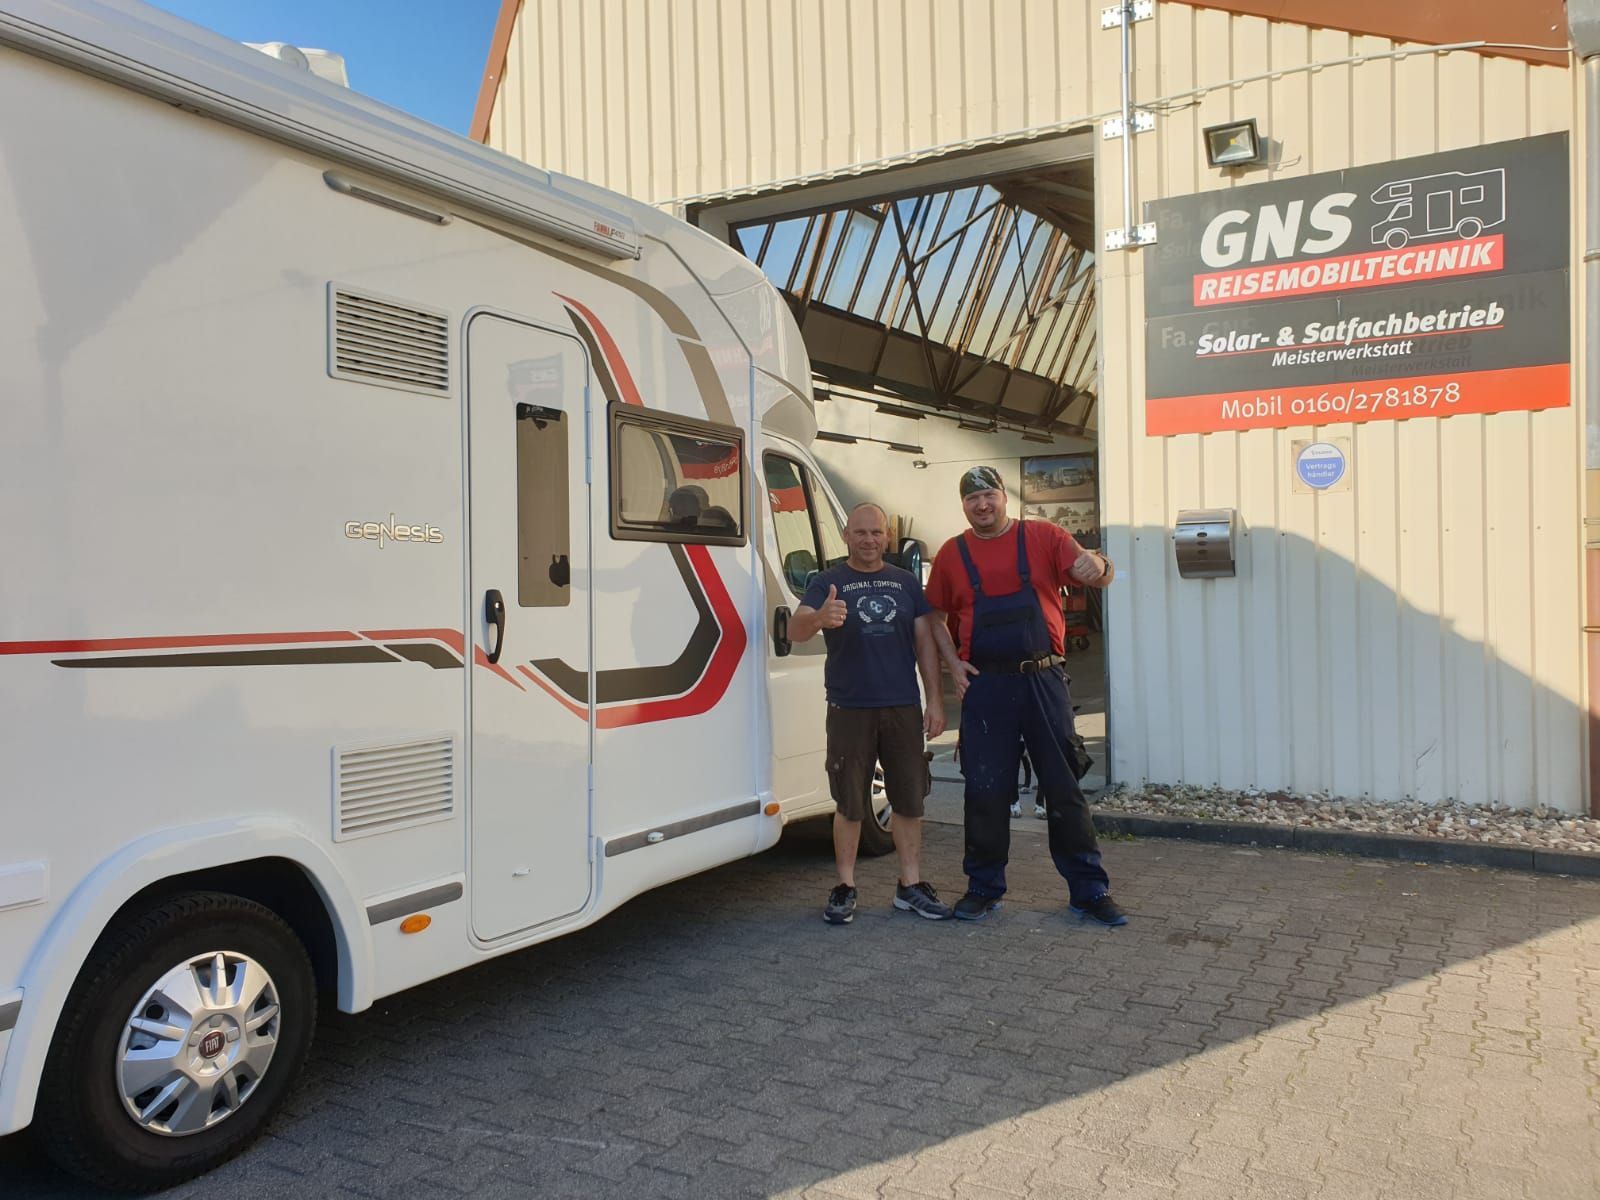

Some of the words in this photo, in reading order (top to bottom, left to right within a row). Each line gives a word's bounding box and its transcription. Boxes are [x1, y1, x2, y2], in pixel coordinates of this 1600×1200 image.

[1200, 192, 1358, 268] GNS
[1199, 241, 1496, 301] REISEMOBILTECHNIK
[1196, 331, 1270, 355] Solar-
[1277, 326, 1296, 347] &
[1302, 302, 1505, 346] Satfachbetrieb
[1271, 340, 1414, 367] Meisterwerkstatt
[1221, 396, 1282, 420] Mobil
[1290, 382, 1461, 415] 0160/2781878
[205, 1036, 220, 1053] FIAT
